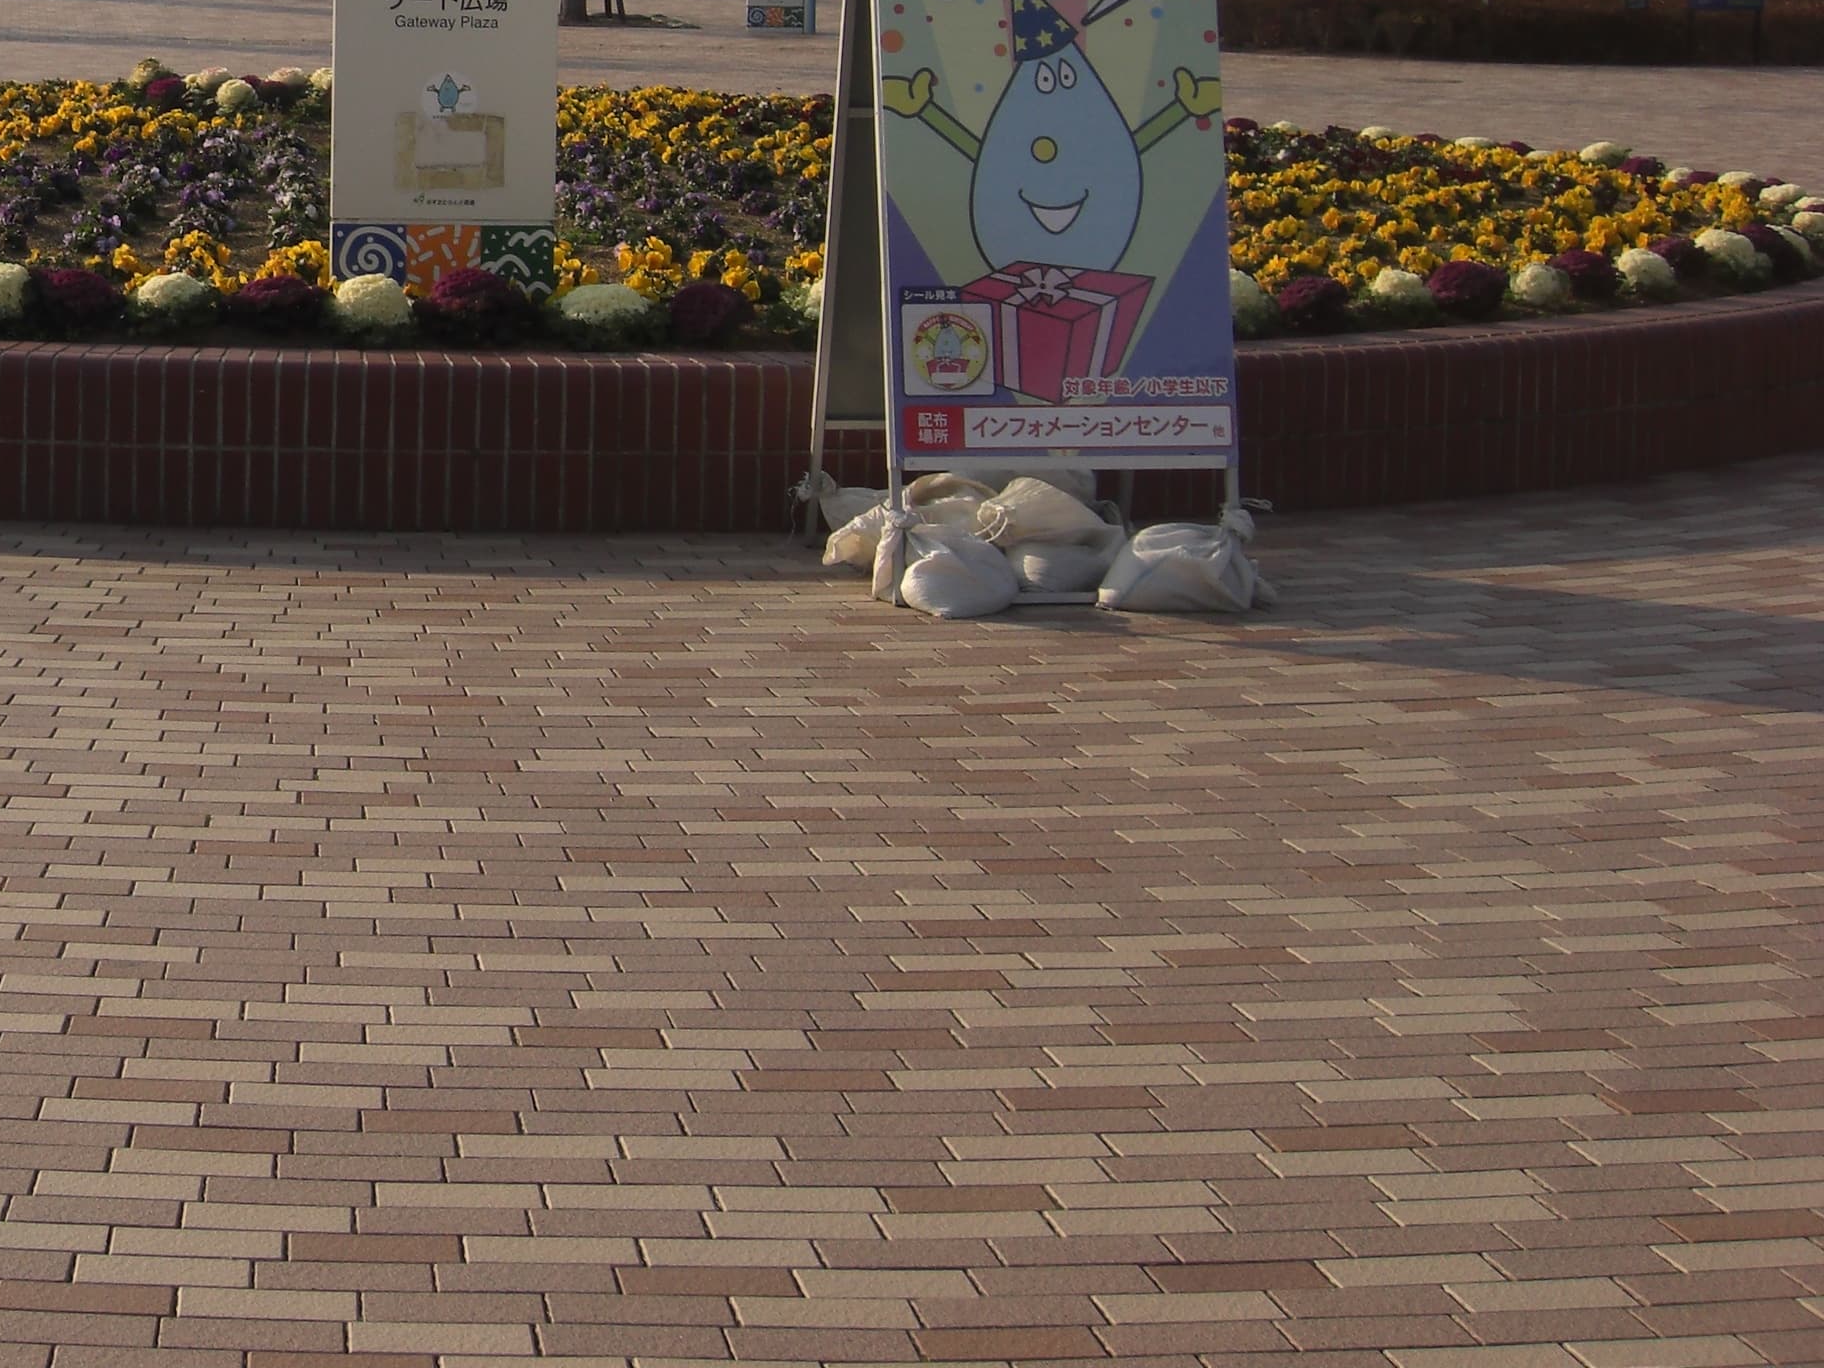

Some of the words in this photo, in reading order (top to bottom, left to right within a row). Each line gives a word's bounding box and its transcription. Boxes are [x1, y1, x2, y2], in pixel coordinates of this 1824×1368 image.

[394, 14, 456, 31] Gateway
[461, 15, 499, 29] Plaza
[903, 289, 957, 301] シール見本
[917, 412, 949, 428] 配布
[972, 415, 1209, 439] インフォメーションセンター
[917, 429, 949, 444] 場所
